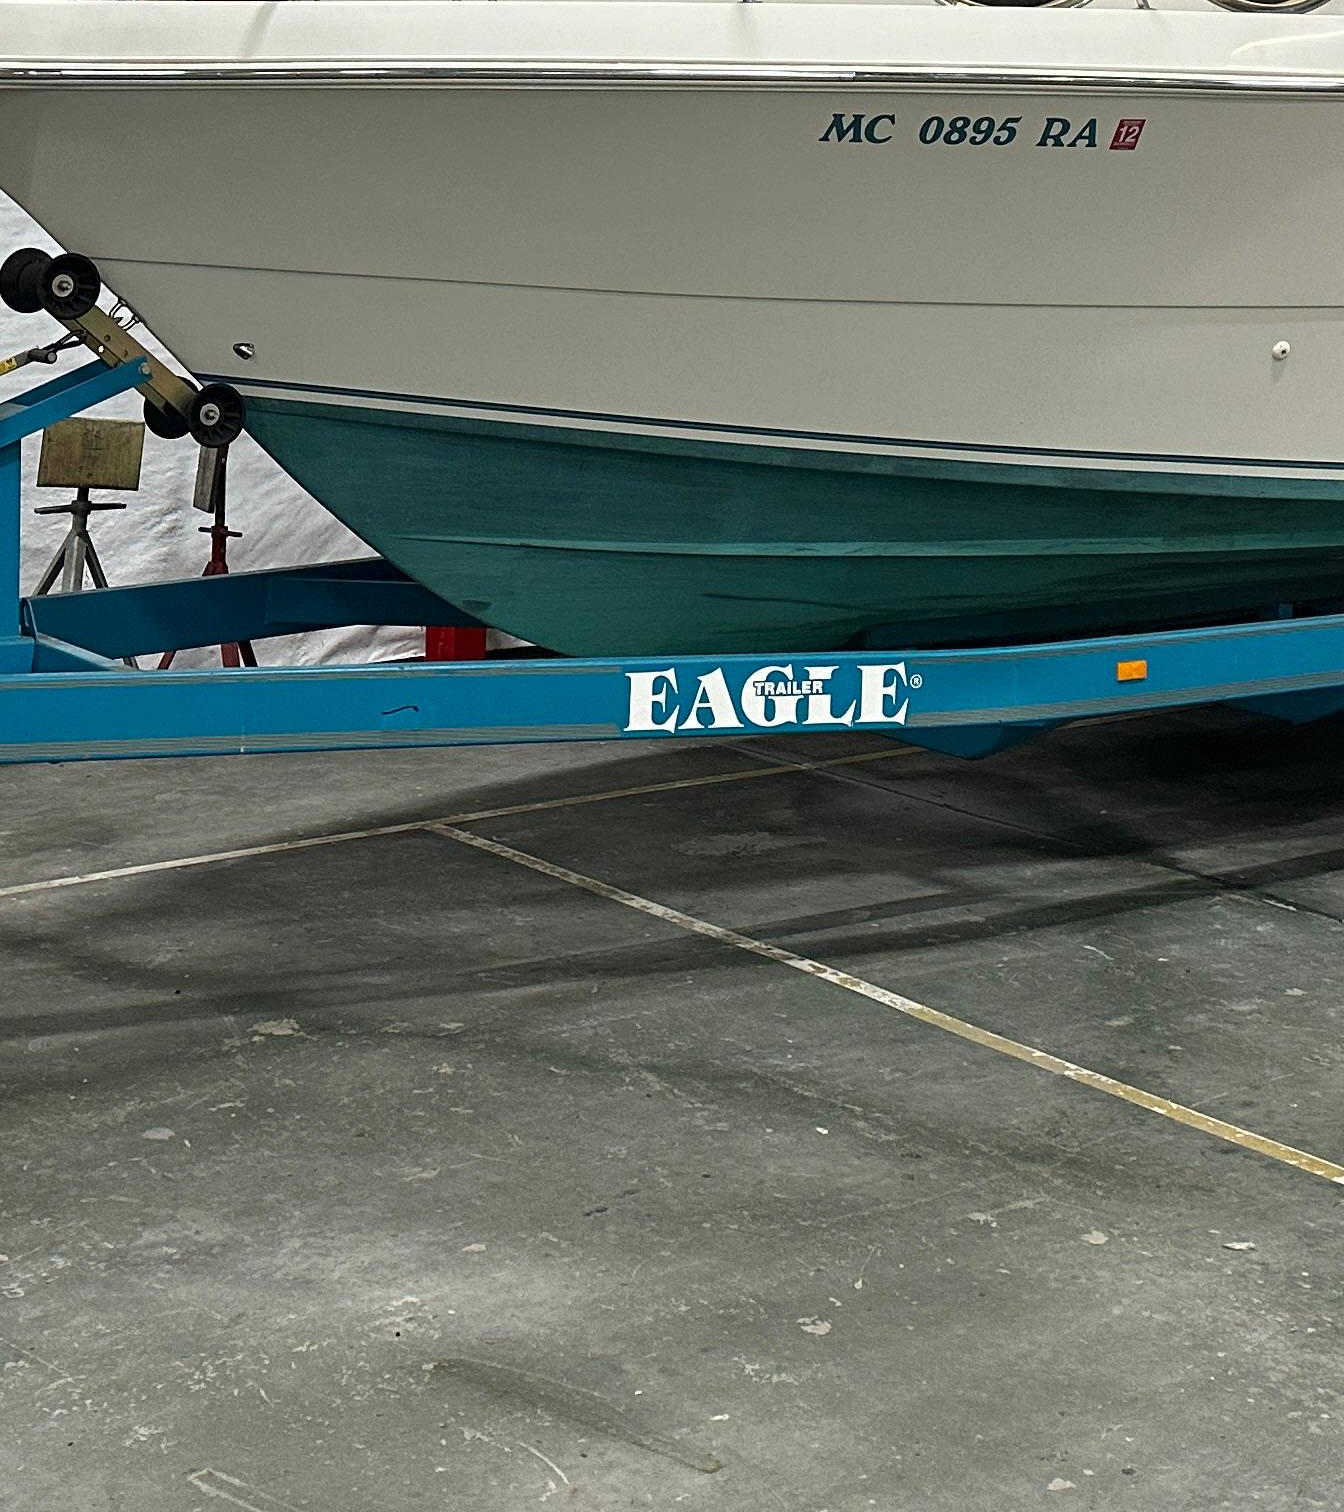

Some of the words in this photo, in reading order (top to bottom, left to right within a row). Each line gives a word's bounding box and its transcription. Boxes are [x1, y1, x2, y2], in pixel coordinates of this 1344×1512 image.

[818, 112, 896, 145] MC
[917, 115, 1022, 147] 0895
[1035, 117, 1098, 149] RA
[1118, 125, 1140, 144] 12
[623, 661, 910, 734] EAGLE
[754, 679, 824, 697] TRAILER
